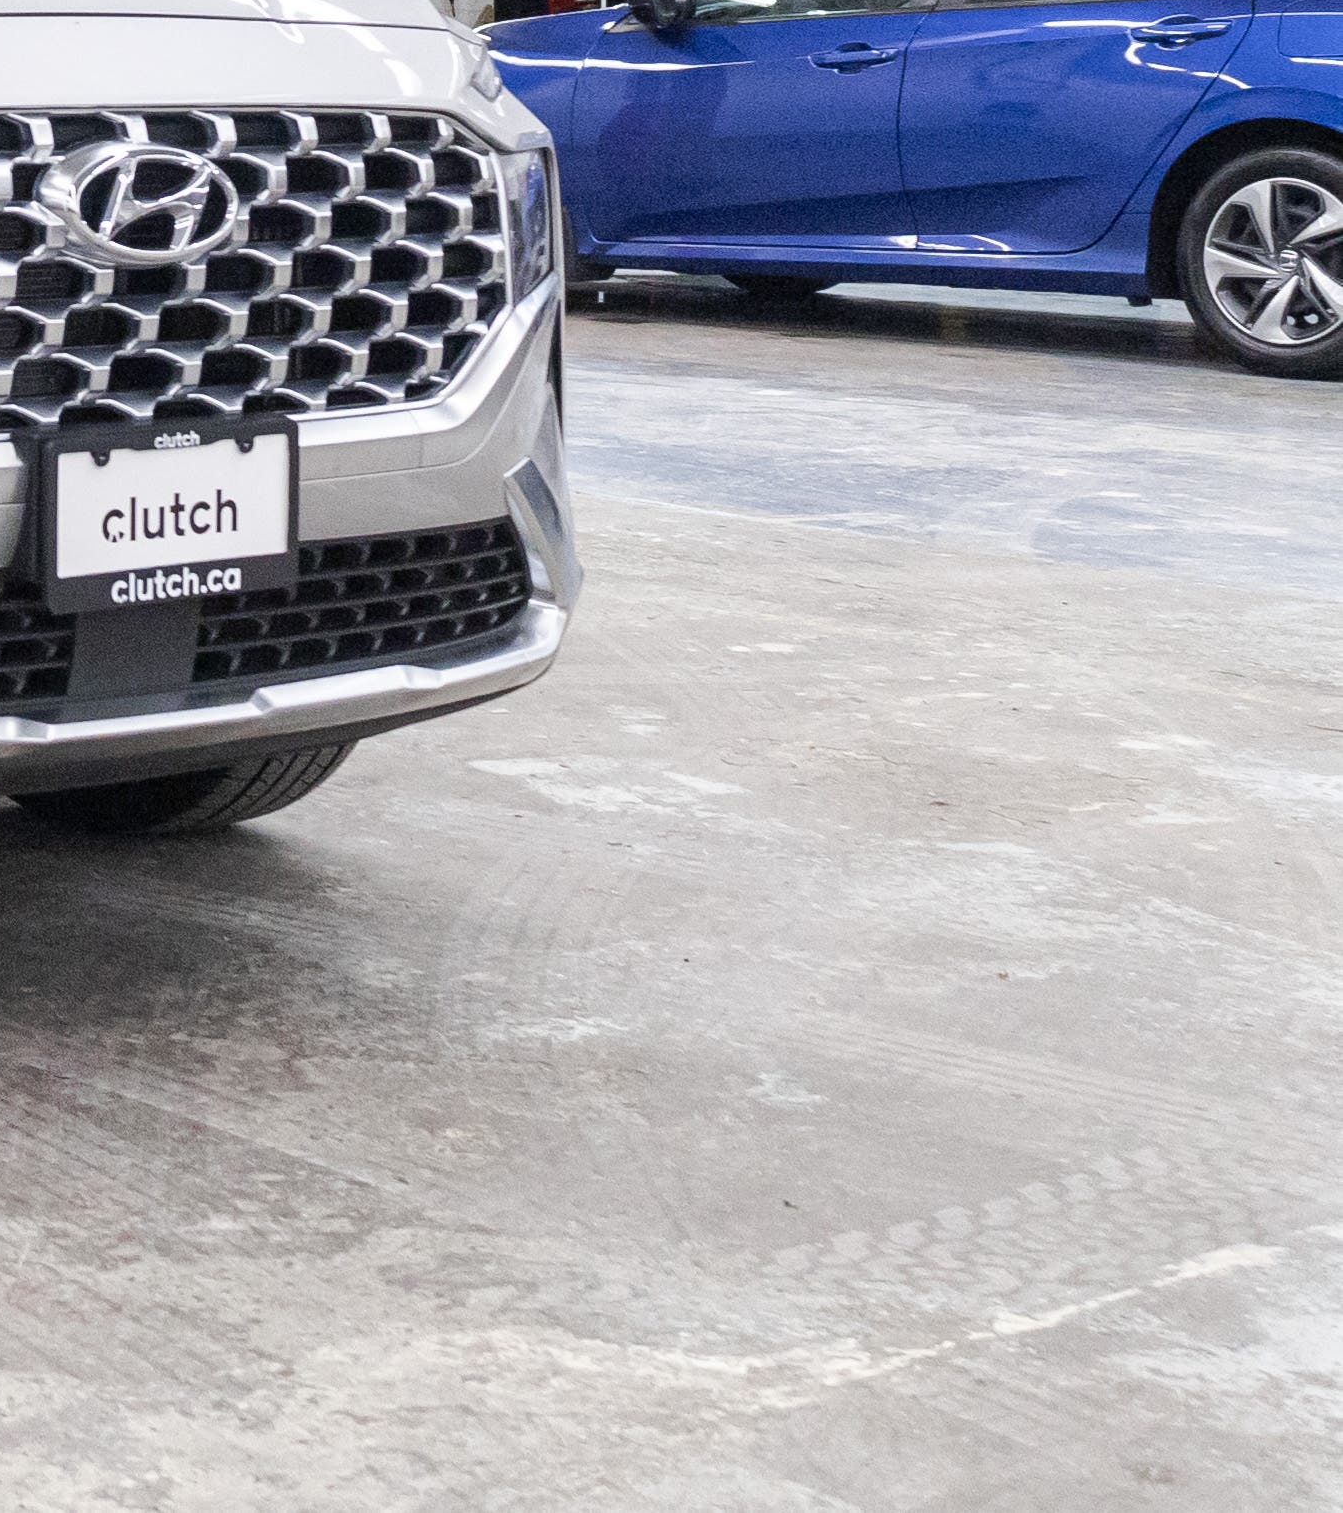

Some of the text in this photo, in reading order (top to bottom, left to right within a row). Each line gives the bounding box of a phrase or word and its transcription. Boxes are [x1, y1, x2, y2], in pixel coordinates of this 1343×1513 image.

[153, 430, 201, 449] clutch
[102, 489, 238, 543] clutch
[111, 566, 242, 604] clutch.ca
